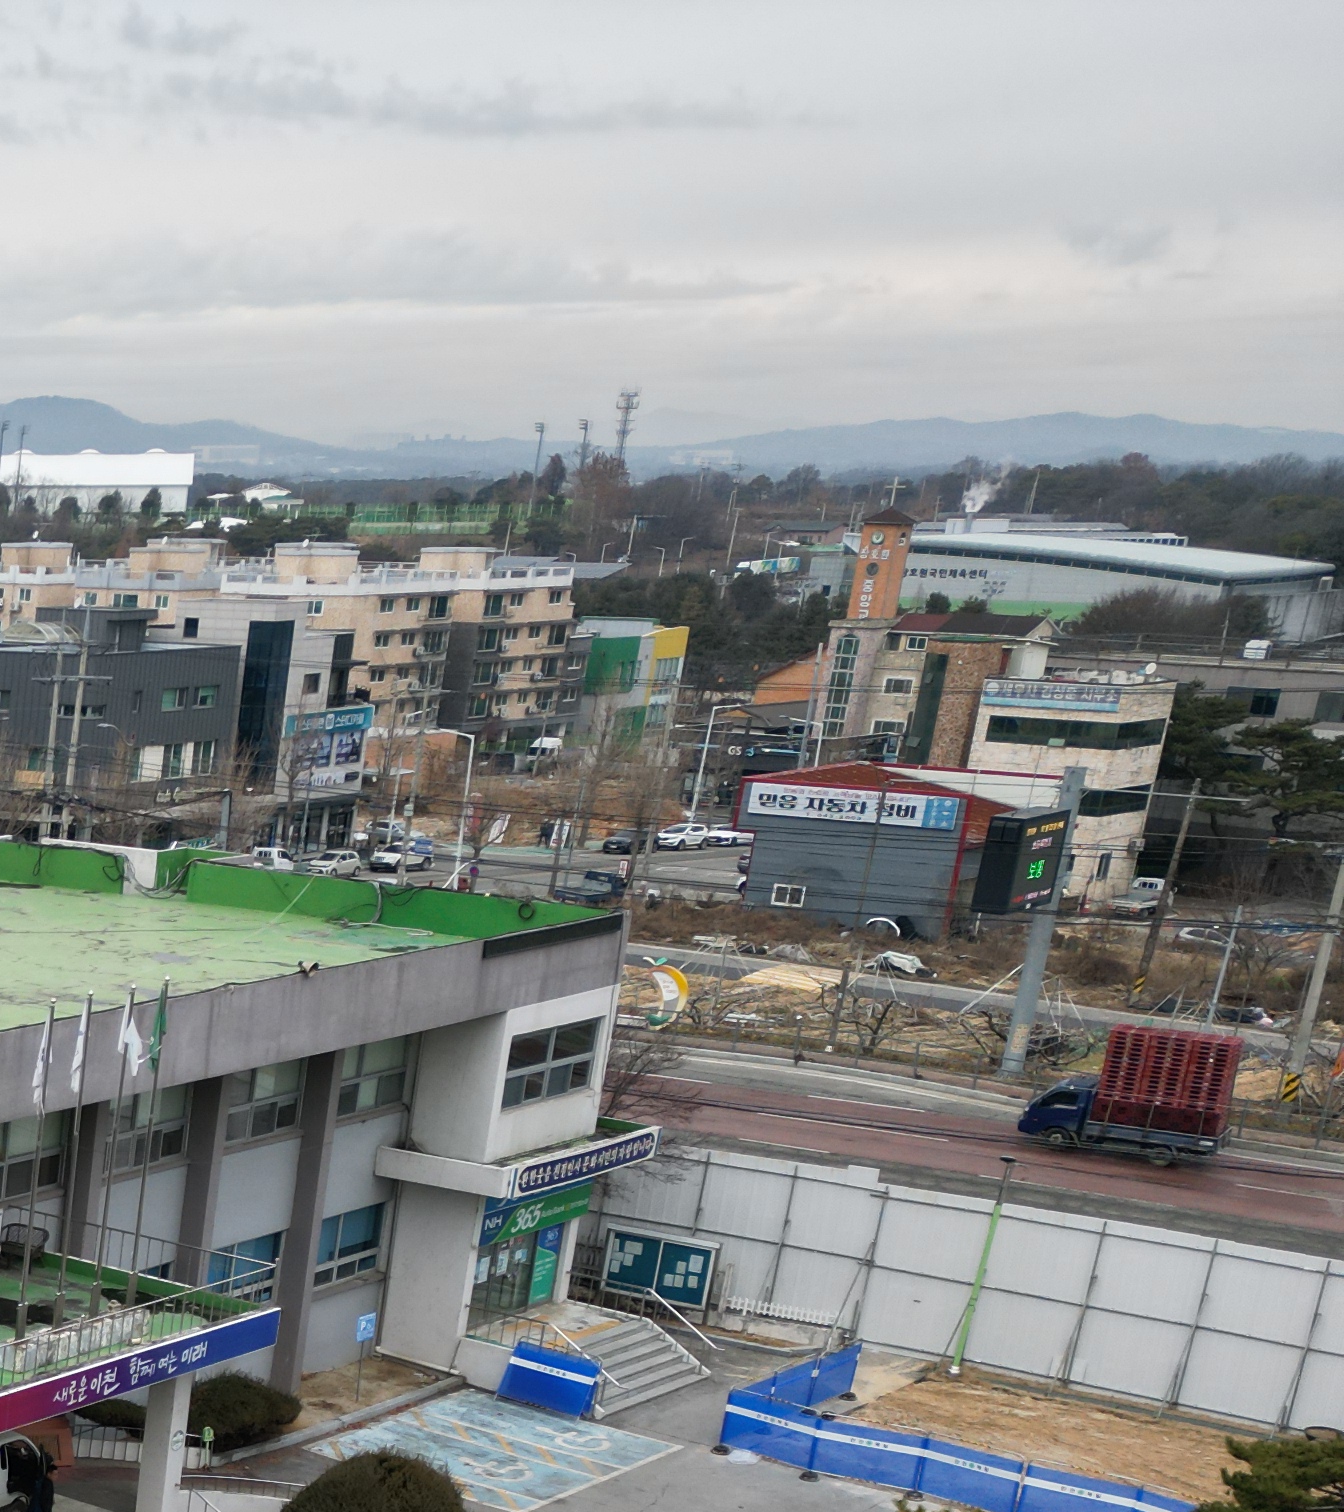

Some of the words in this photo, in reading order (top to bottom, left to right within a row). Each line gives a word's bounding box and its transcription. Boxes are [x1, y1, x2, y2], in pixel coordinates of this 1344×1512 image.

[758, 793, 798, 809] 믿음
[803, 797, 868, 815] 자동차
[484, 1214, 503, 1231] NH
[511, 1202, 545, 1234] 365
[53, 1375, 88, 1406] 새로운
[91, 1366, 121, 1396] 이천
[129, 1356, 156, 1386] 함께
[181, 1341, 208, 1365] 미래
